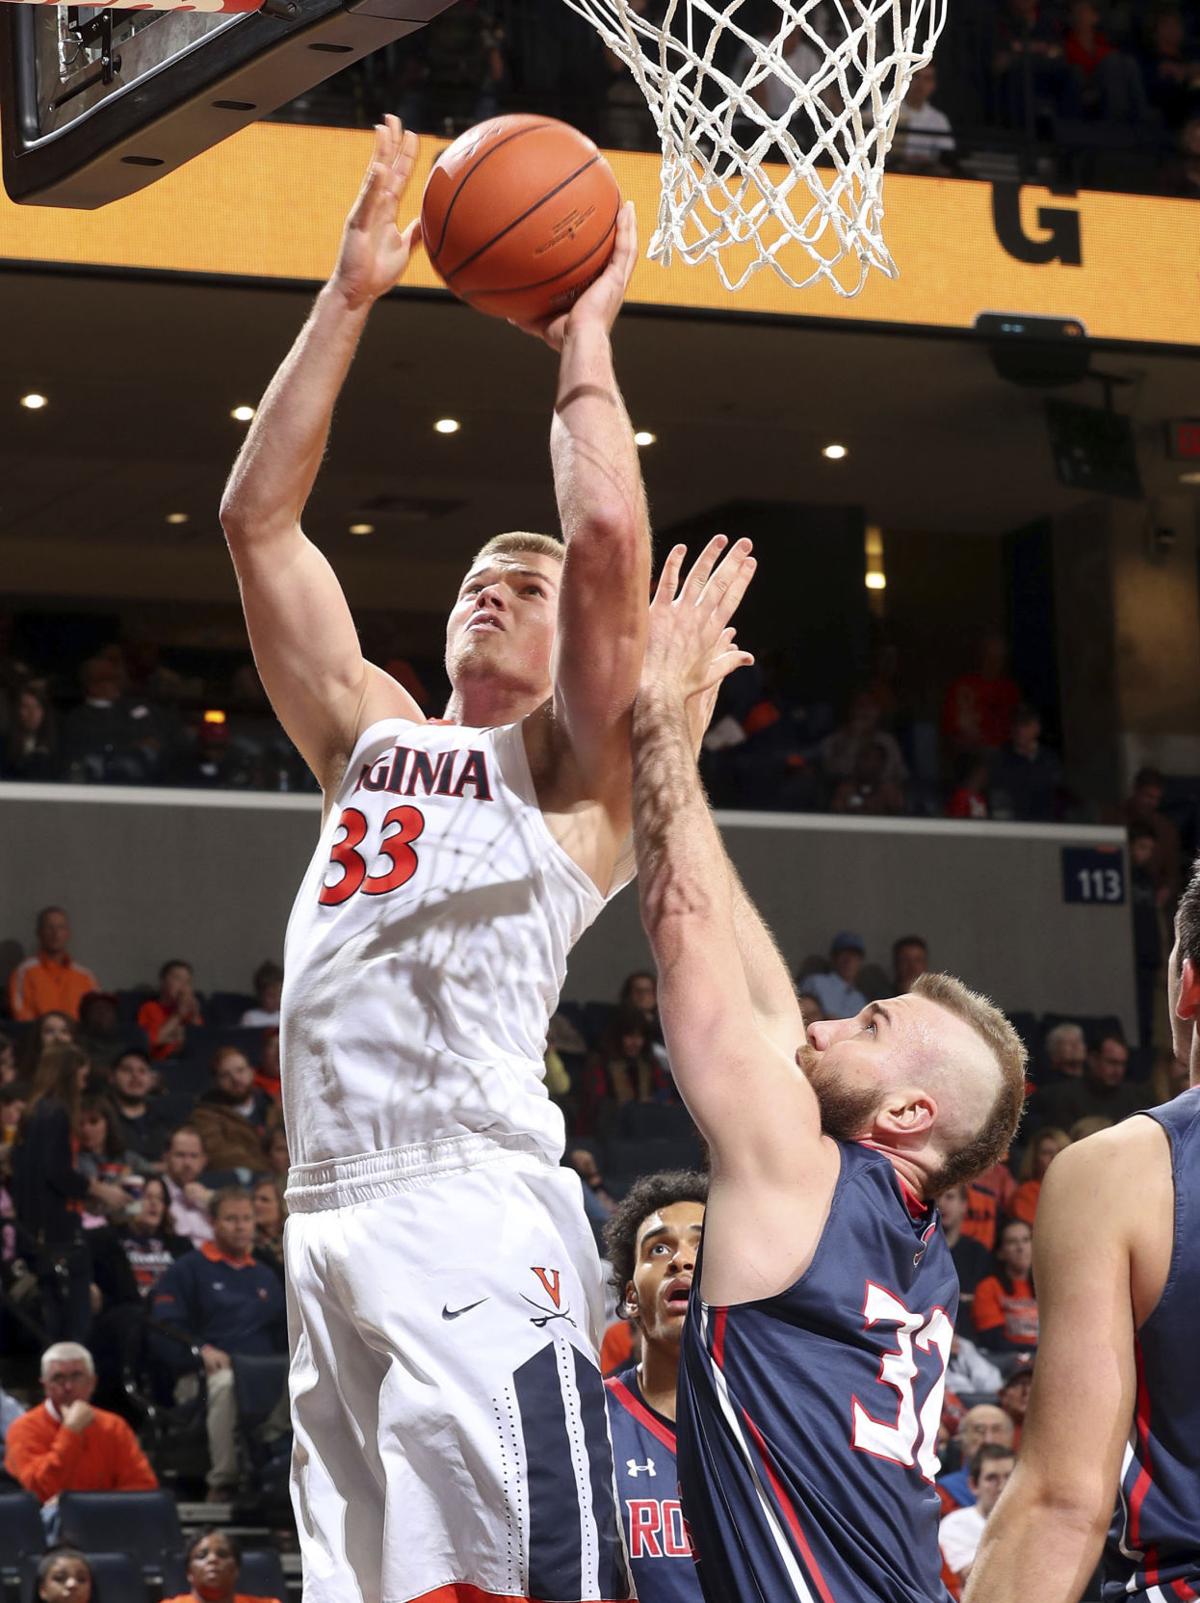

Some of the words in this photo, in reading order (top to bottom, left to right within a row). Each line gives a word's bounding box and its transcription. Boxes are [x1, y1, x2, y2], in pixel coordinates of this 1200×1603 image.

[991, 181, 1083, 268] G
[318, 805, 425, 906] 33
[1077, 869, 1121, 900] 113
[850, 1280, 954, 1484] 32
